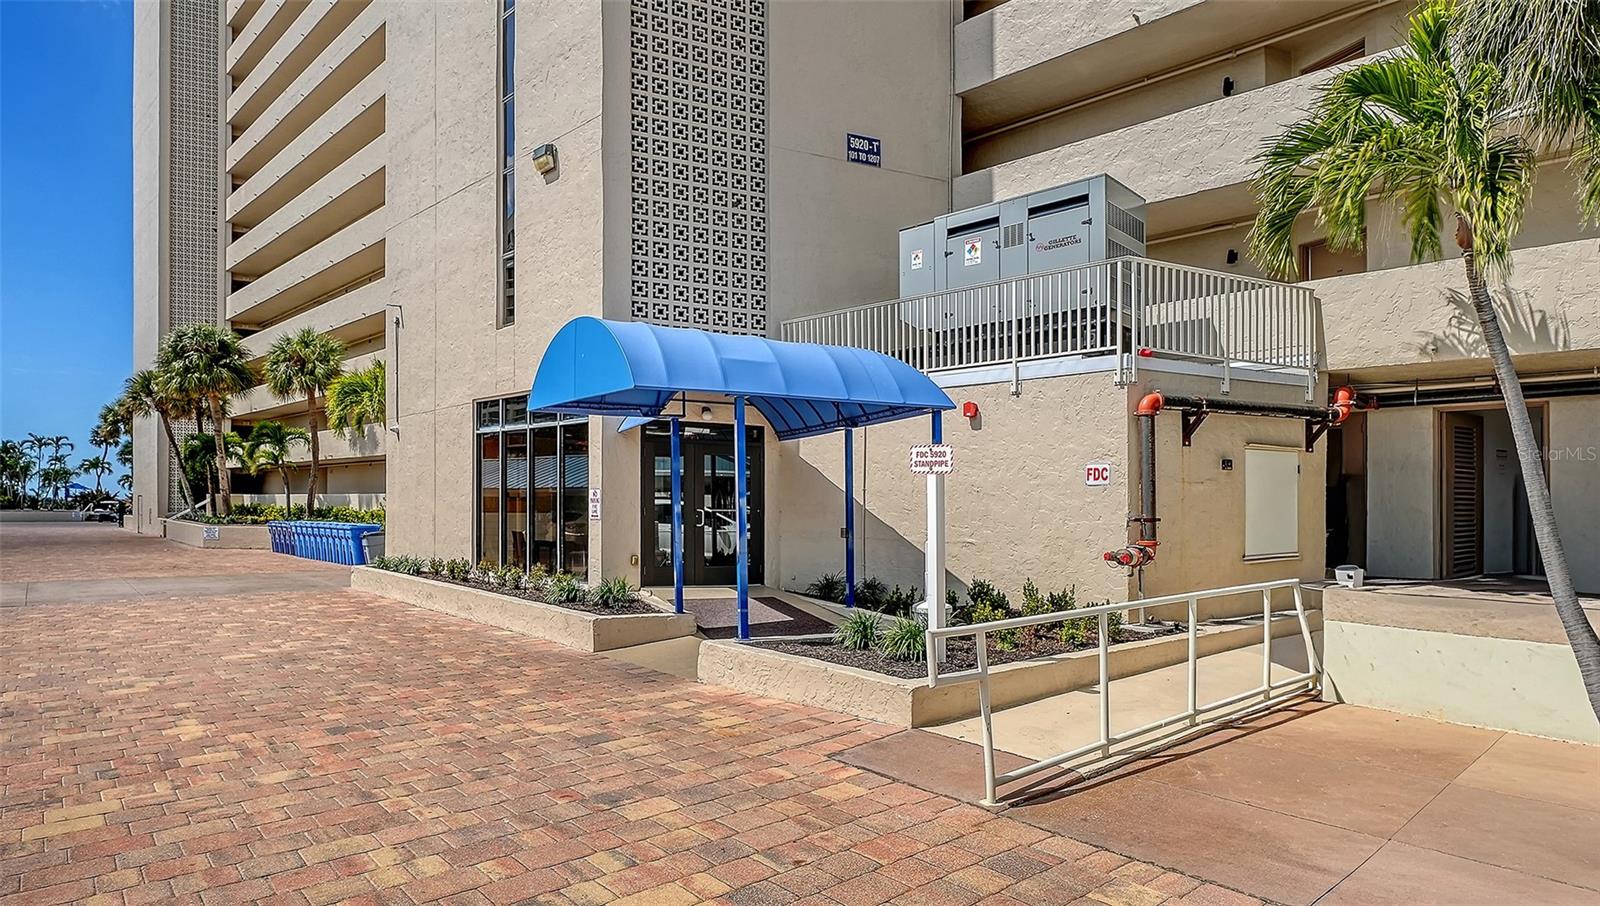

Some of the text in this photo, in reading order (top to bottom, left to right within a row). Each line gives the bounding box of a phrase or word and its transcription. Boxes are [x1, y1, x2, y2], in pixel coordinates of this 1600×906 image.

[849, 151, 880, 164] 101 TO 1207
[1043, 238, 1082, 251] GENERATORS
[915, 450, 947, 459] FDC 5920
[914, 460, 949, 468] STANDPIPE
[1086, 467, 1109, 481] FDC
